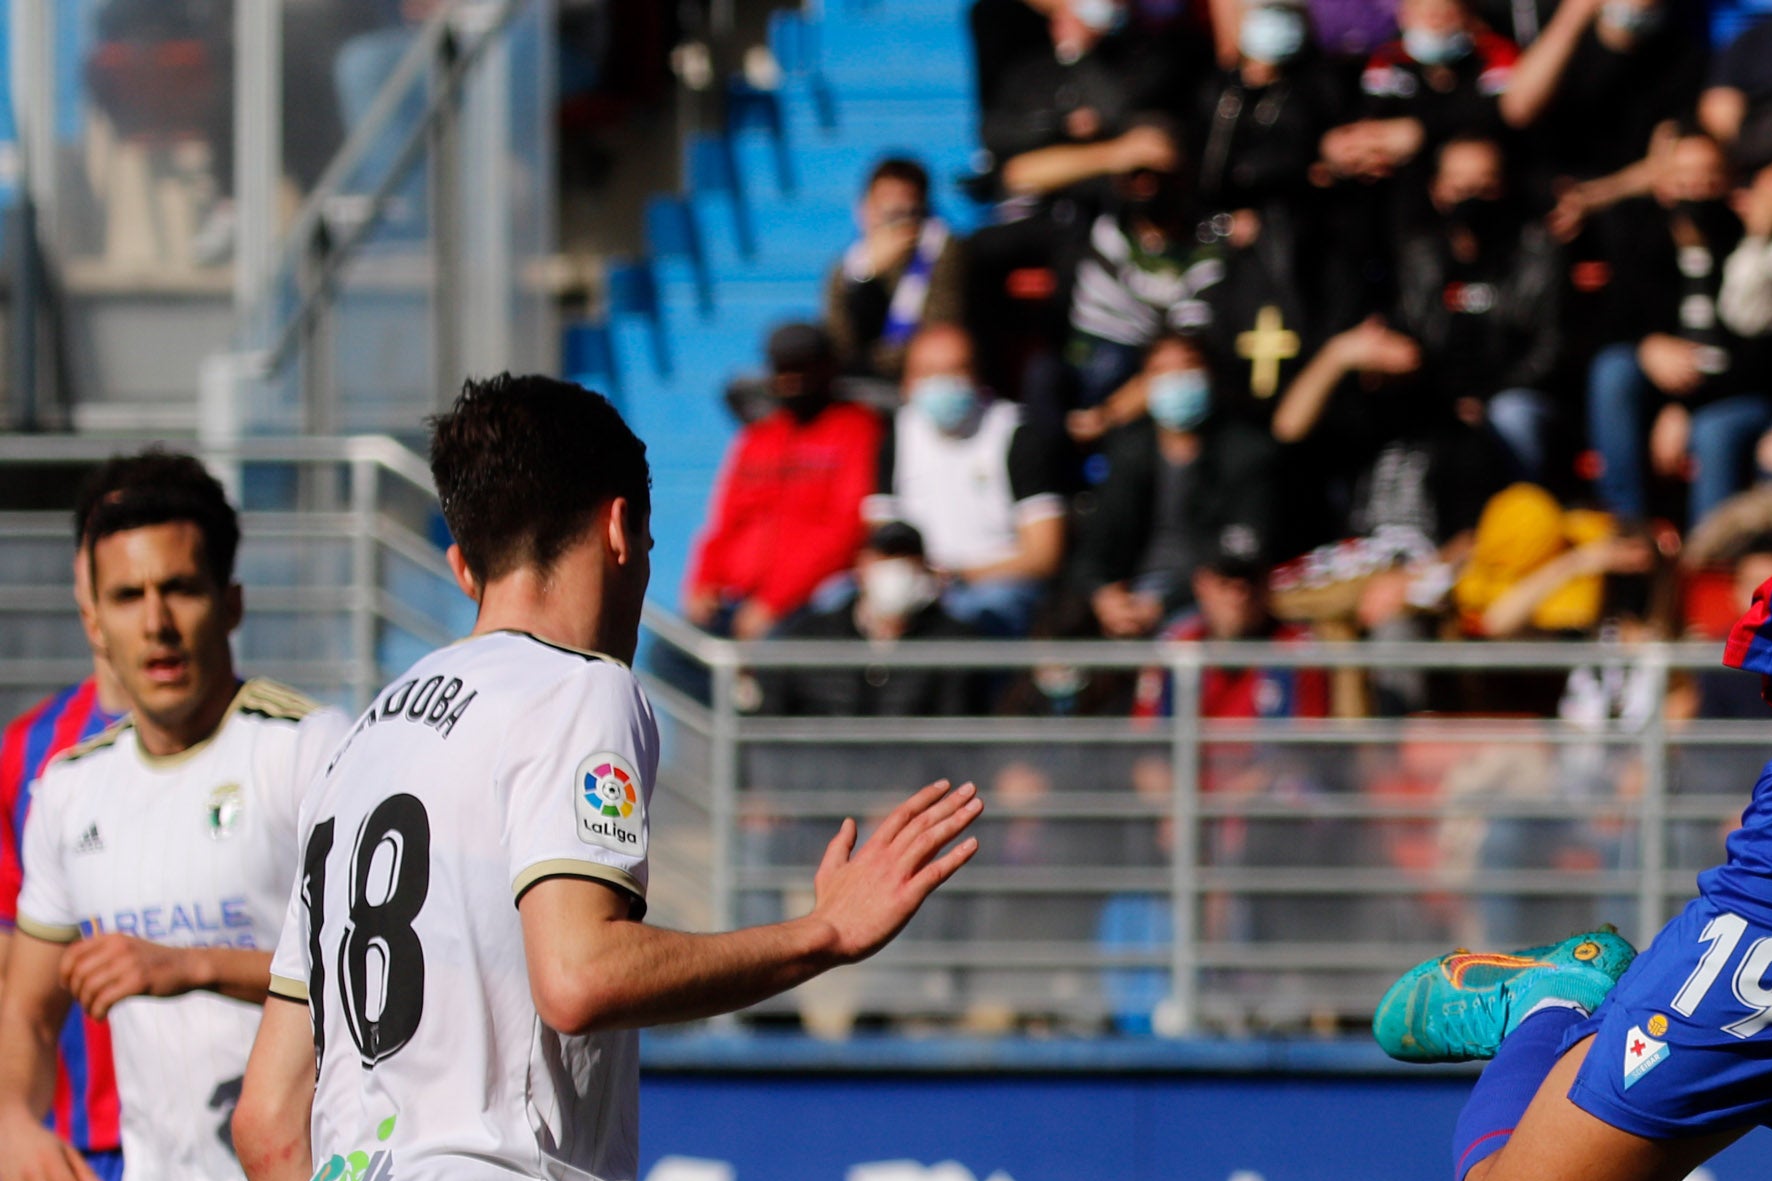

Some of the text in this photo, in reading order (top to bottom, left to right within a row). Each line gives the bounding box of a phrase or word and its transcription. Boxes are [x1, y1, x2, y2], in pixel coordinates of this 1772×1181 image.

[583, 818, 637, 844] LaLiga
[113, 896, 254, 941] REALE
[301, 792, 431, 1092] 18
